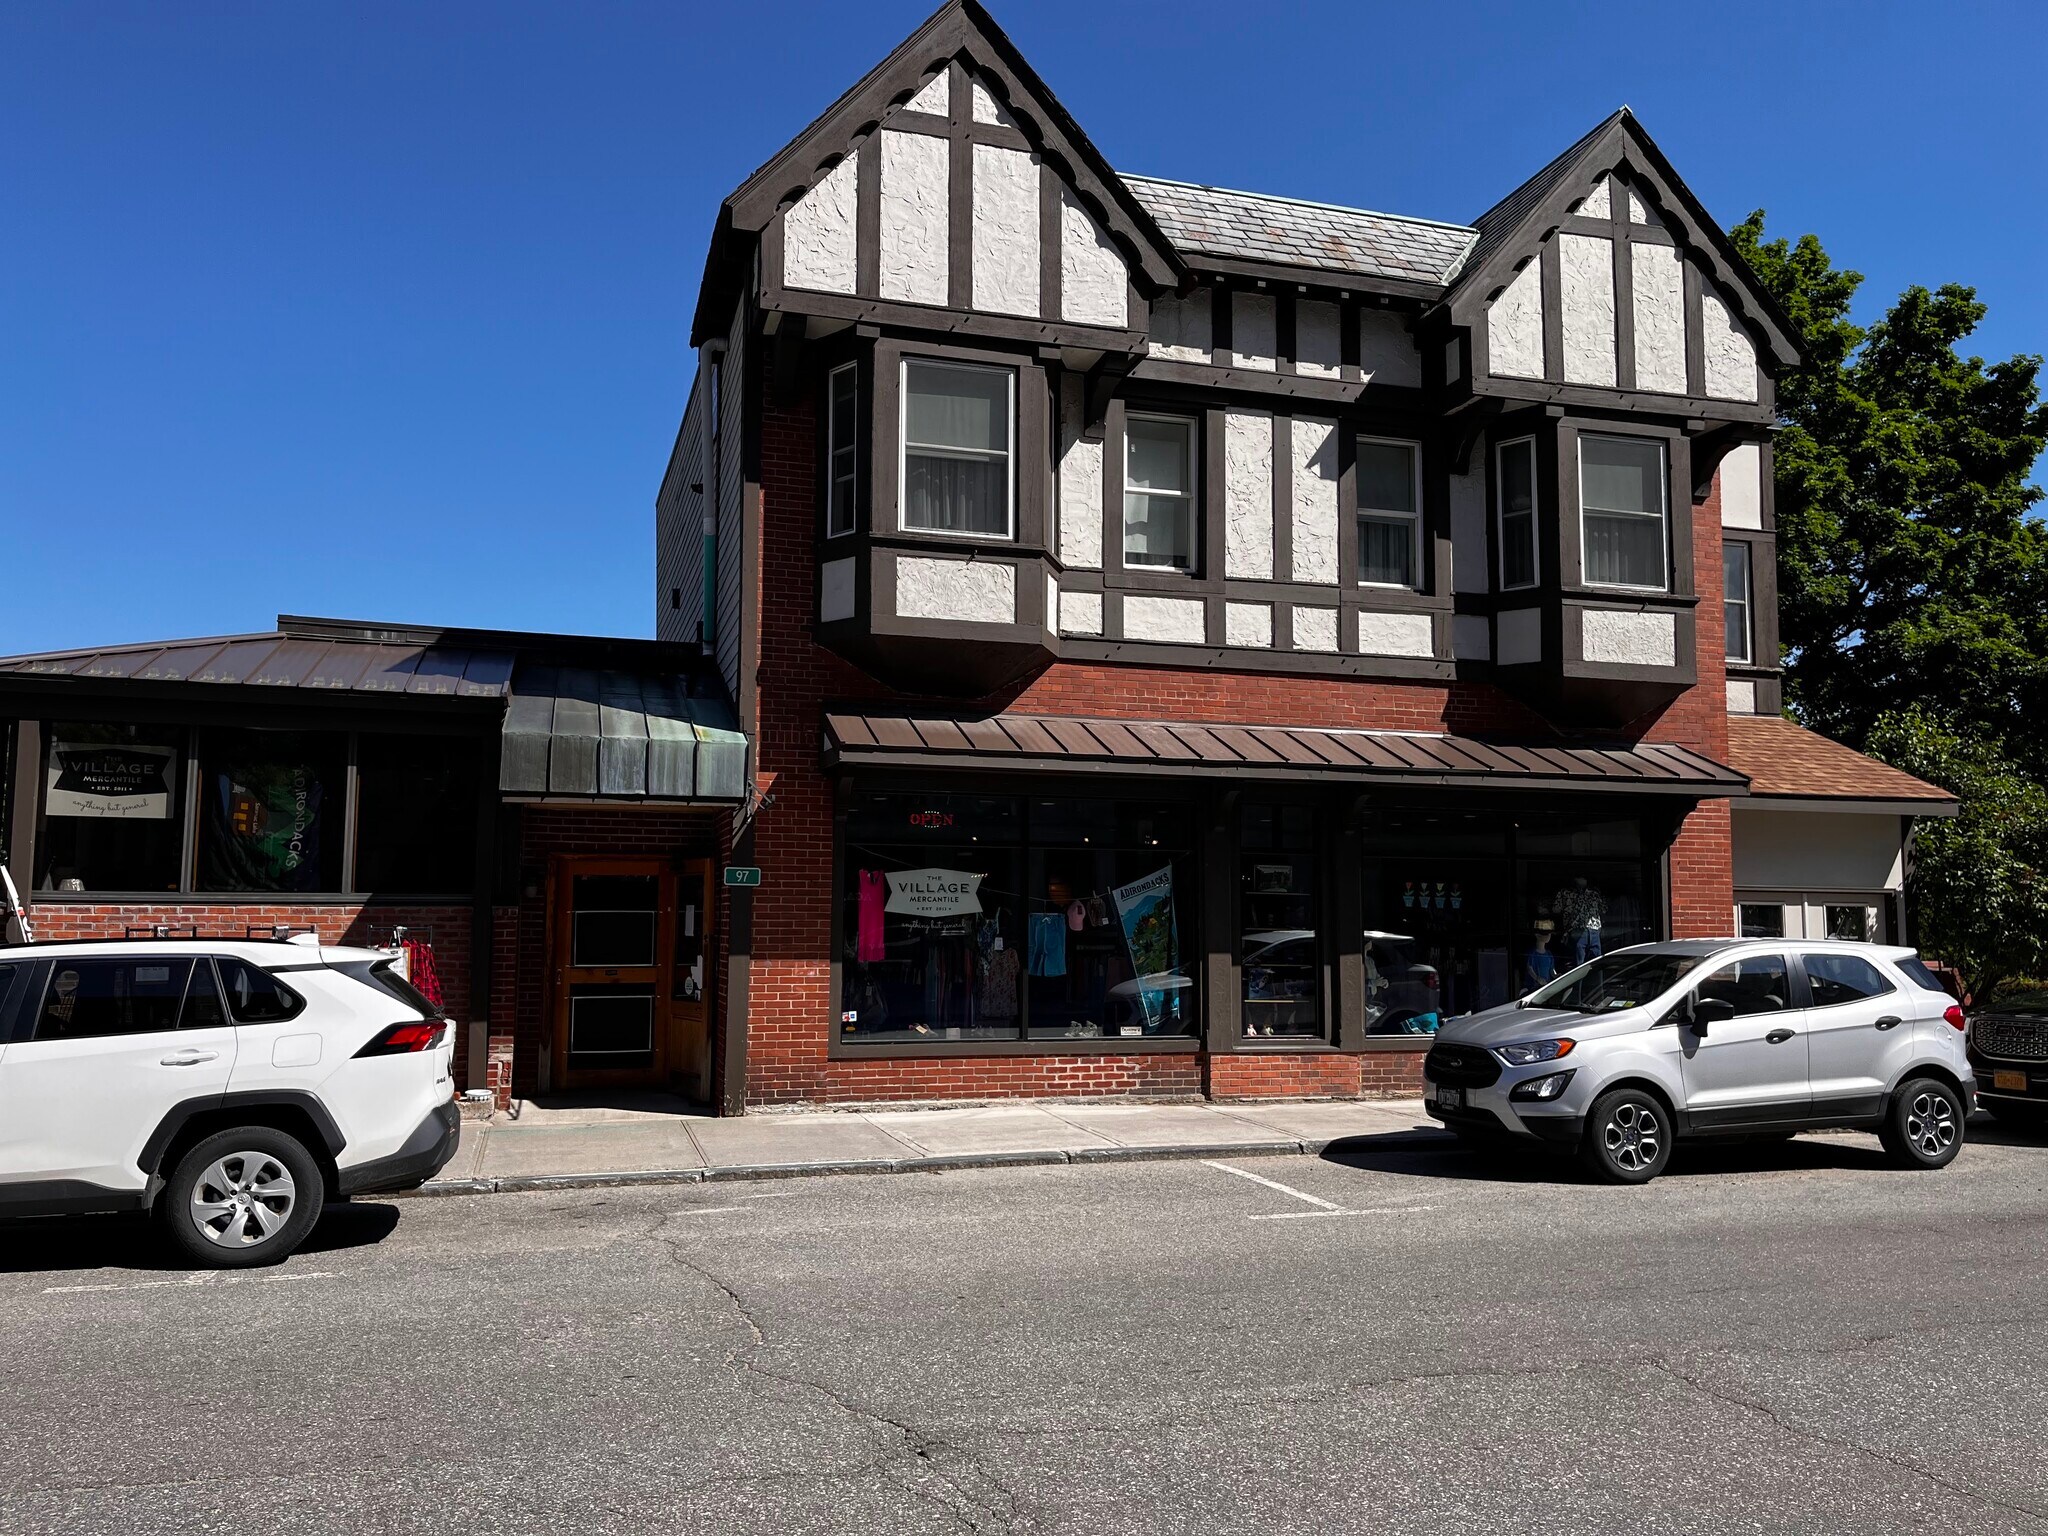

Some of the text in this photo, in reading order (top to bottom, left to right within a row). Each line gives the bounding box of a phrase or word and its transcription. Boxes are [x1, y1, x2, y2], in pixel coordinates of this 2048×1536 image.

[70, 761, 155, 775] VILLAGE
[82, 775, 143, 784] MERCANTILE
[72, 798, 150, 816] anything but general
[285, 768, 306, 868] ADIRONDACKS
[909, 813, 954, 826] OPEN
[736, 870, 749, 882] 97
[898, 882, 970, 894] VILLAGE
[1120, 873, 1170, 899] ADIRONDACKS
[901, 919, 929, 935] anything
[1998, 1026, 2034, 1037] GMC
